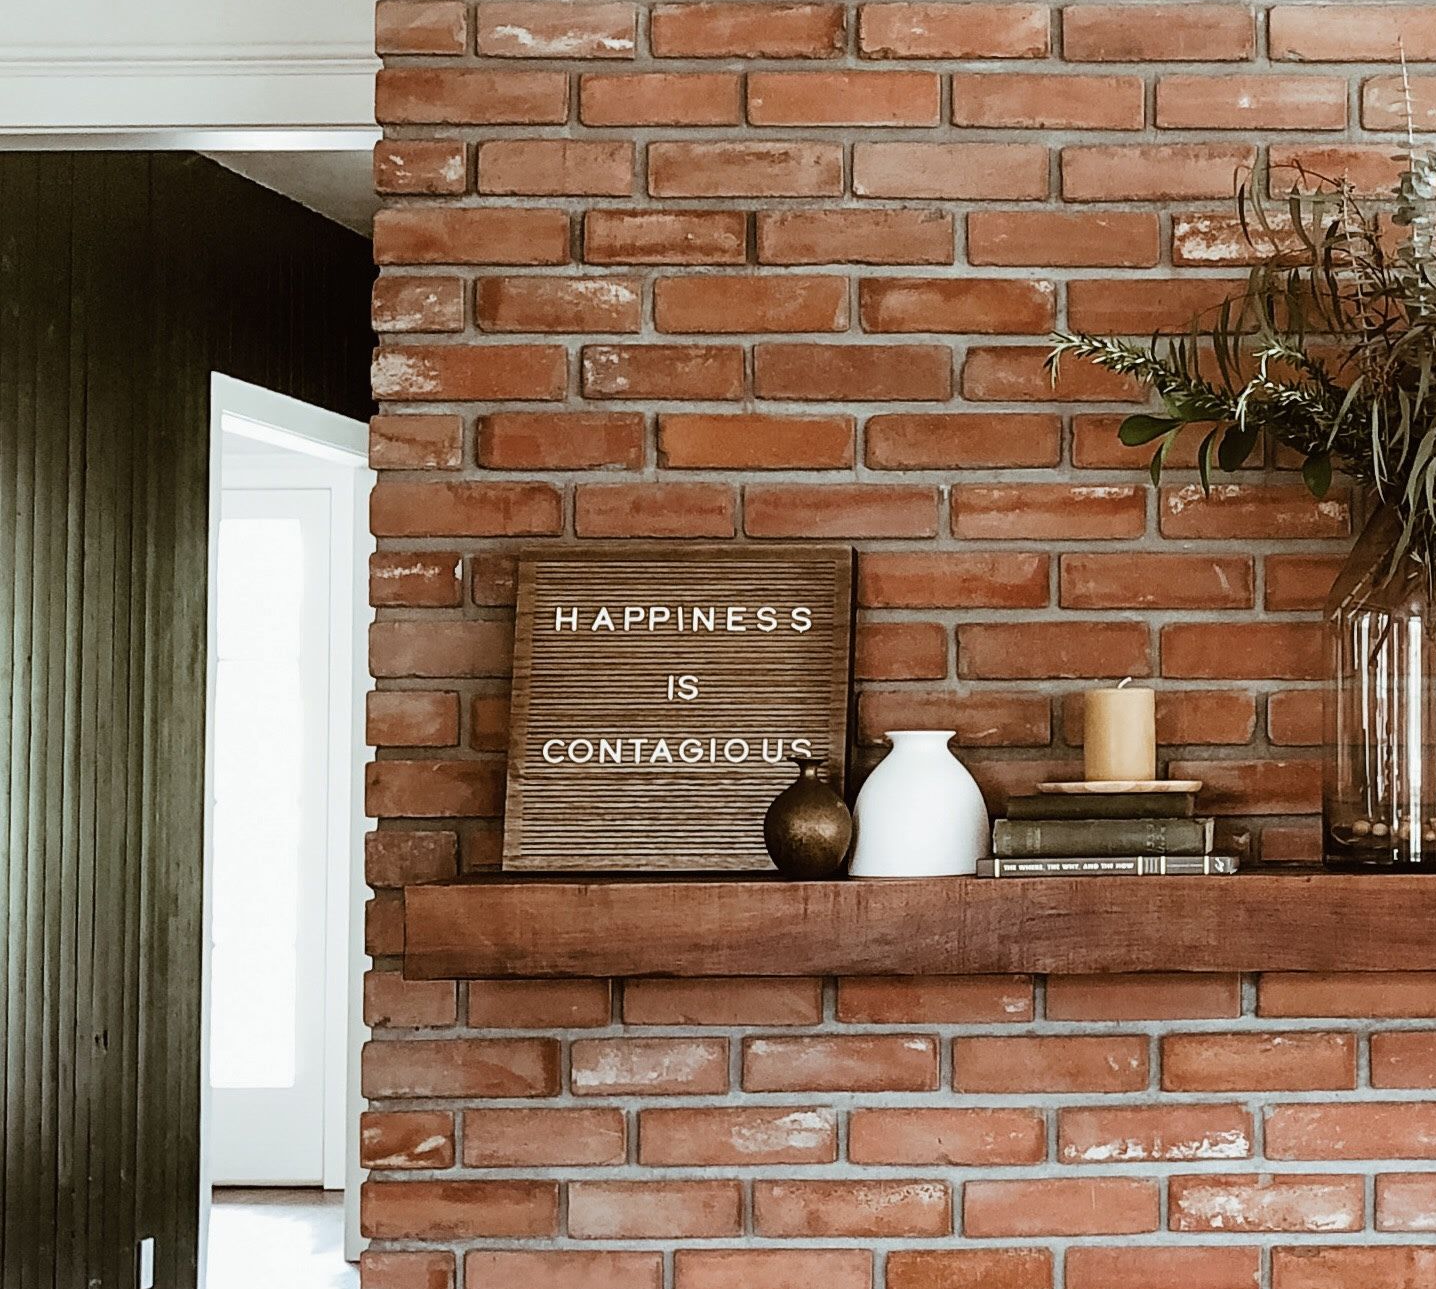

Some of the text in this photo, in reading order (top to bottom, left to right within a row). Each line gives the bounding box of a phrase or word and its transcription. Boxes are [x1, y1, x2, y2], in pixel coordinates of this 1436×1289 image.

[555, 606, 812, 633] HAPPINESS
[666, 674, 699, 701] IS
[542, 737, 812, 763] CONTAGIOUS
[1083, 862, 1100, 870] AND
